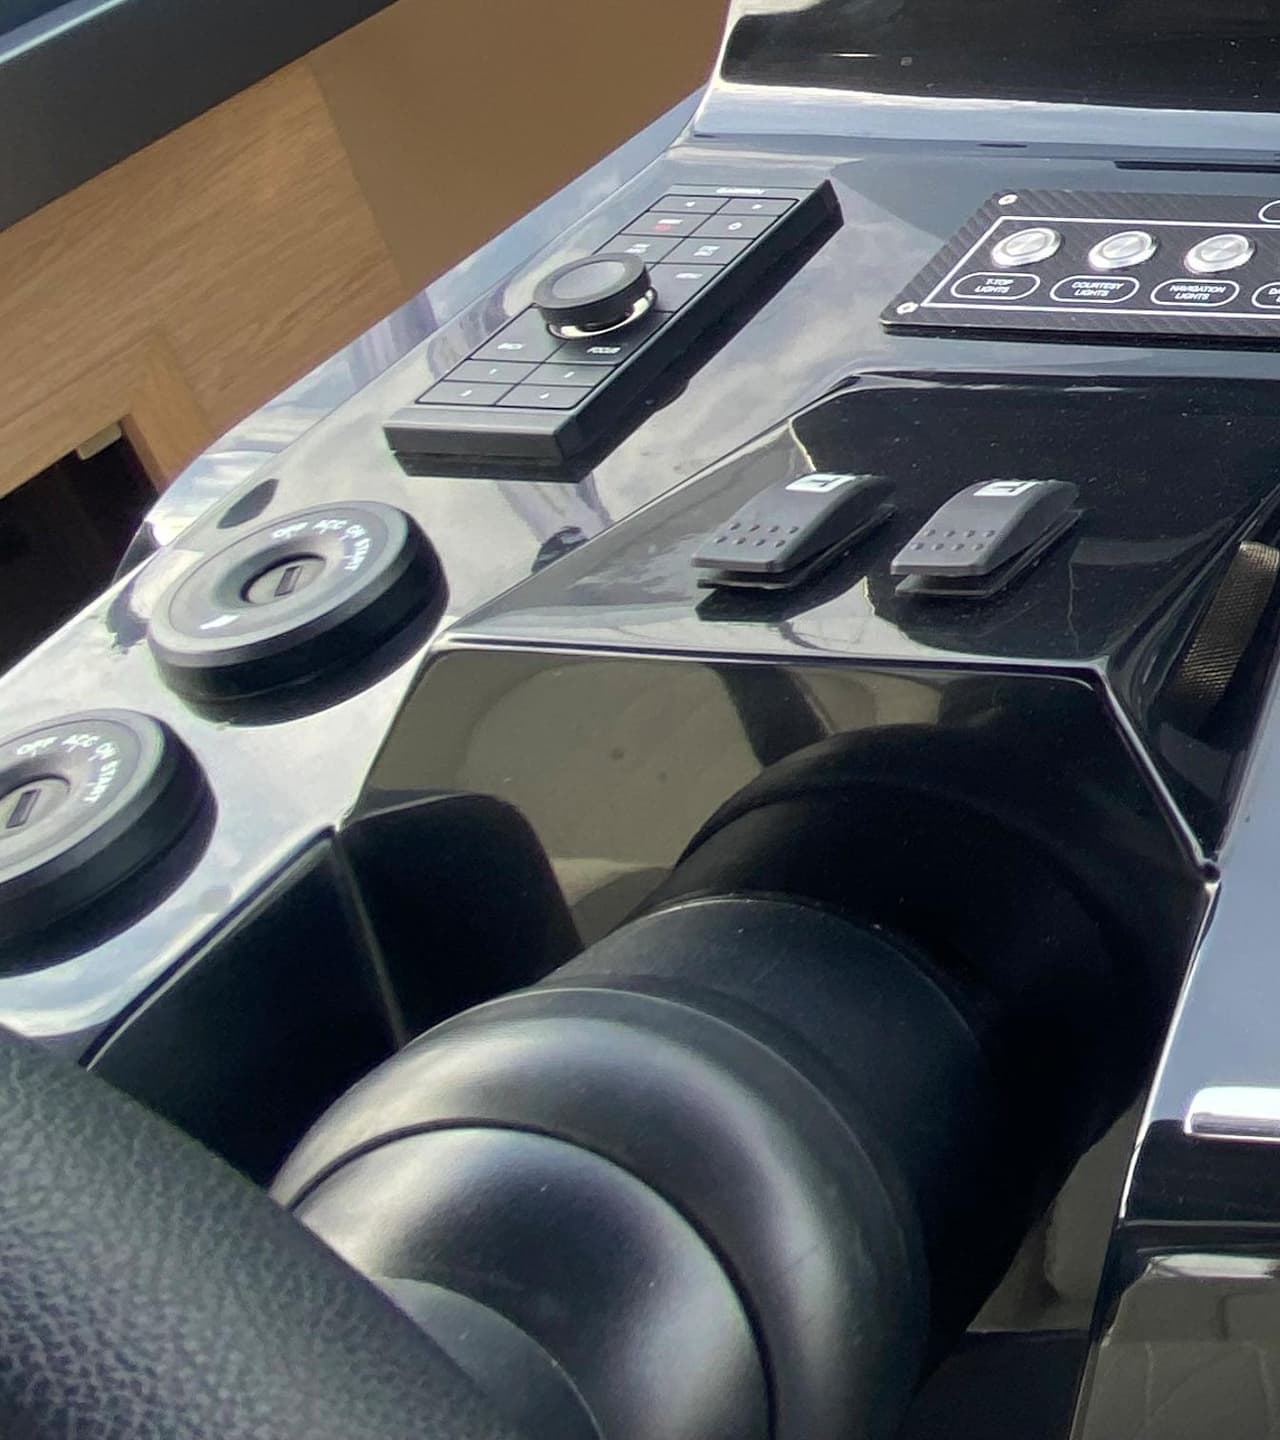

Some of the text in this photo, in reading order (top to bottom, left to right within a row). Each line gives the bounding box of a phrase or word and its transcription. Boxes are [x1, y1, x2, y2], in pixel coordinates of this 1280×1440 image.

[974, 285, 1011, 294] LIGHTS
[1074, 289, 1111, 297] LIGHTS
[1169, 284, 1227, 294] NAVIGATION
[1174, 292, 1211, 301] LIGHTS
